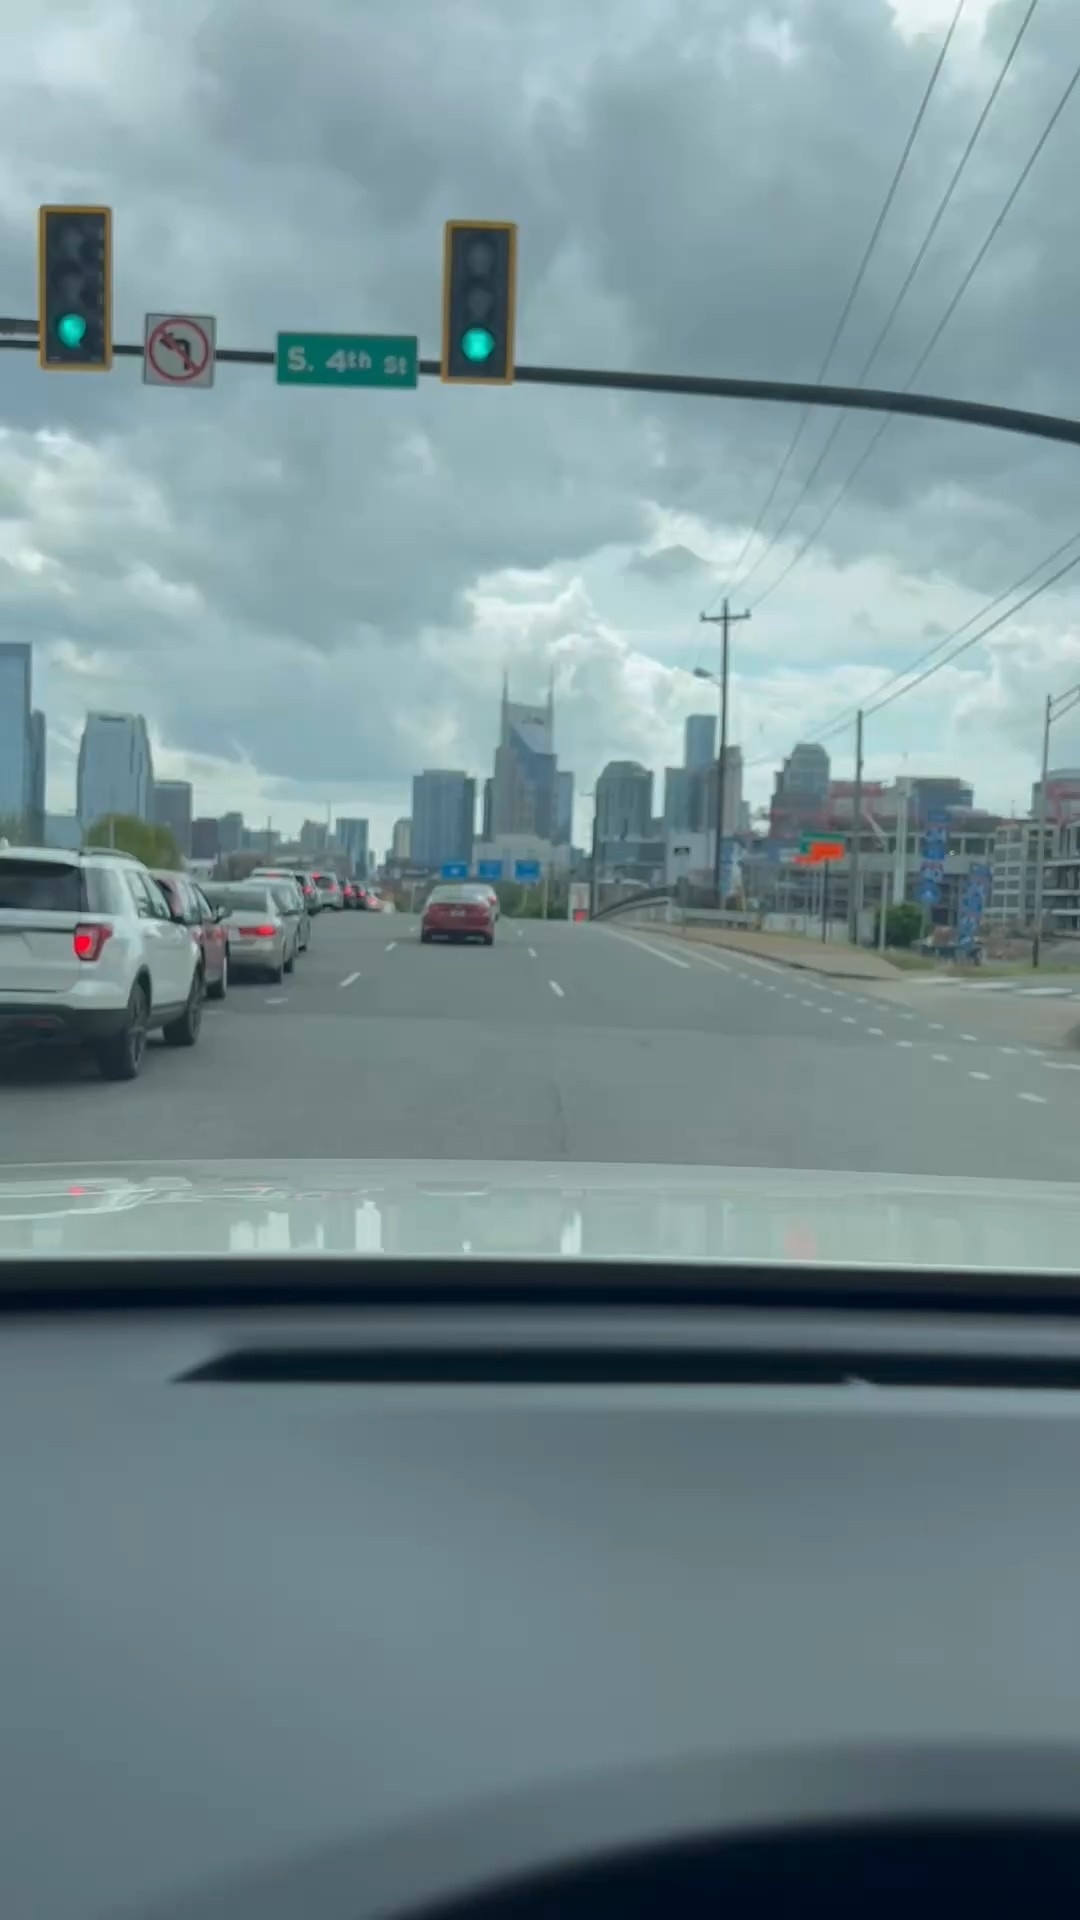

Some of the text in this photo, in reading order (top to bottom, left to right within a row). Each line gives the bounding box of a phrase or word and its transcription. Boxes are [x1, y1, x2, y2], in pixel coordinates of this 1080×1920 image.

[287, 346, 409, 375] S. 4th St
